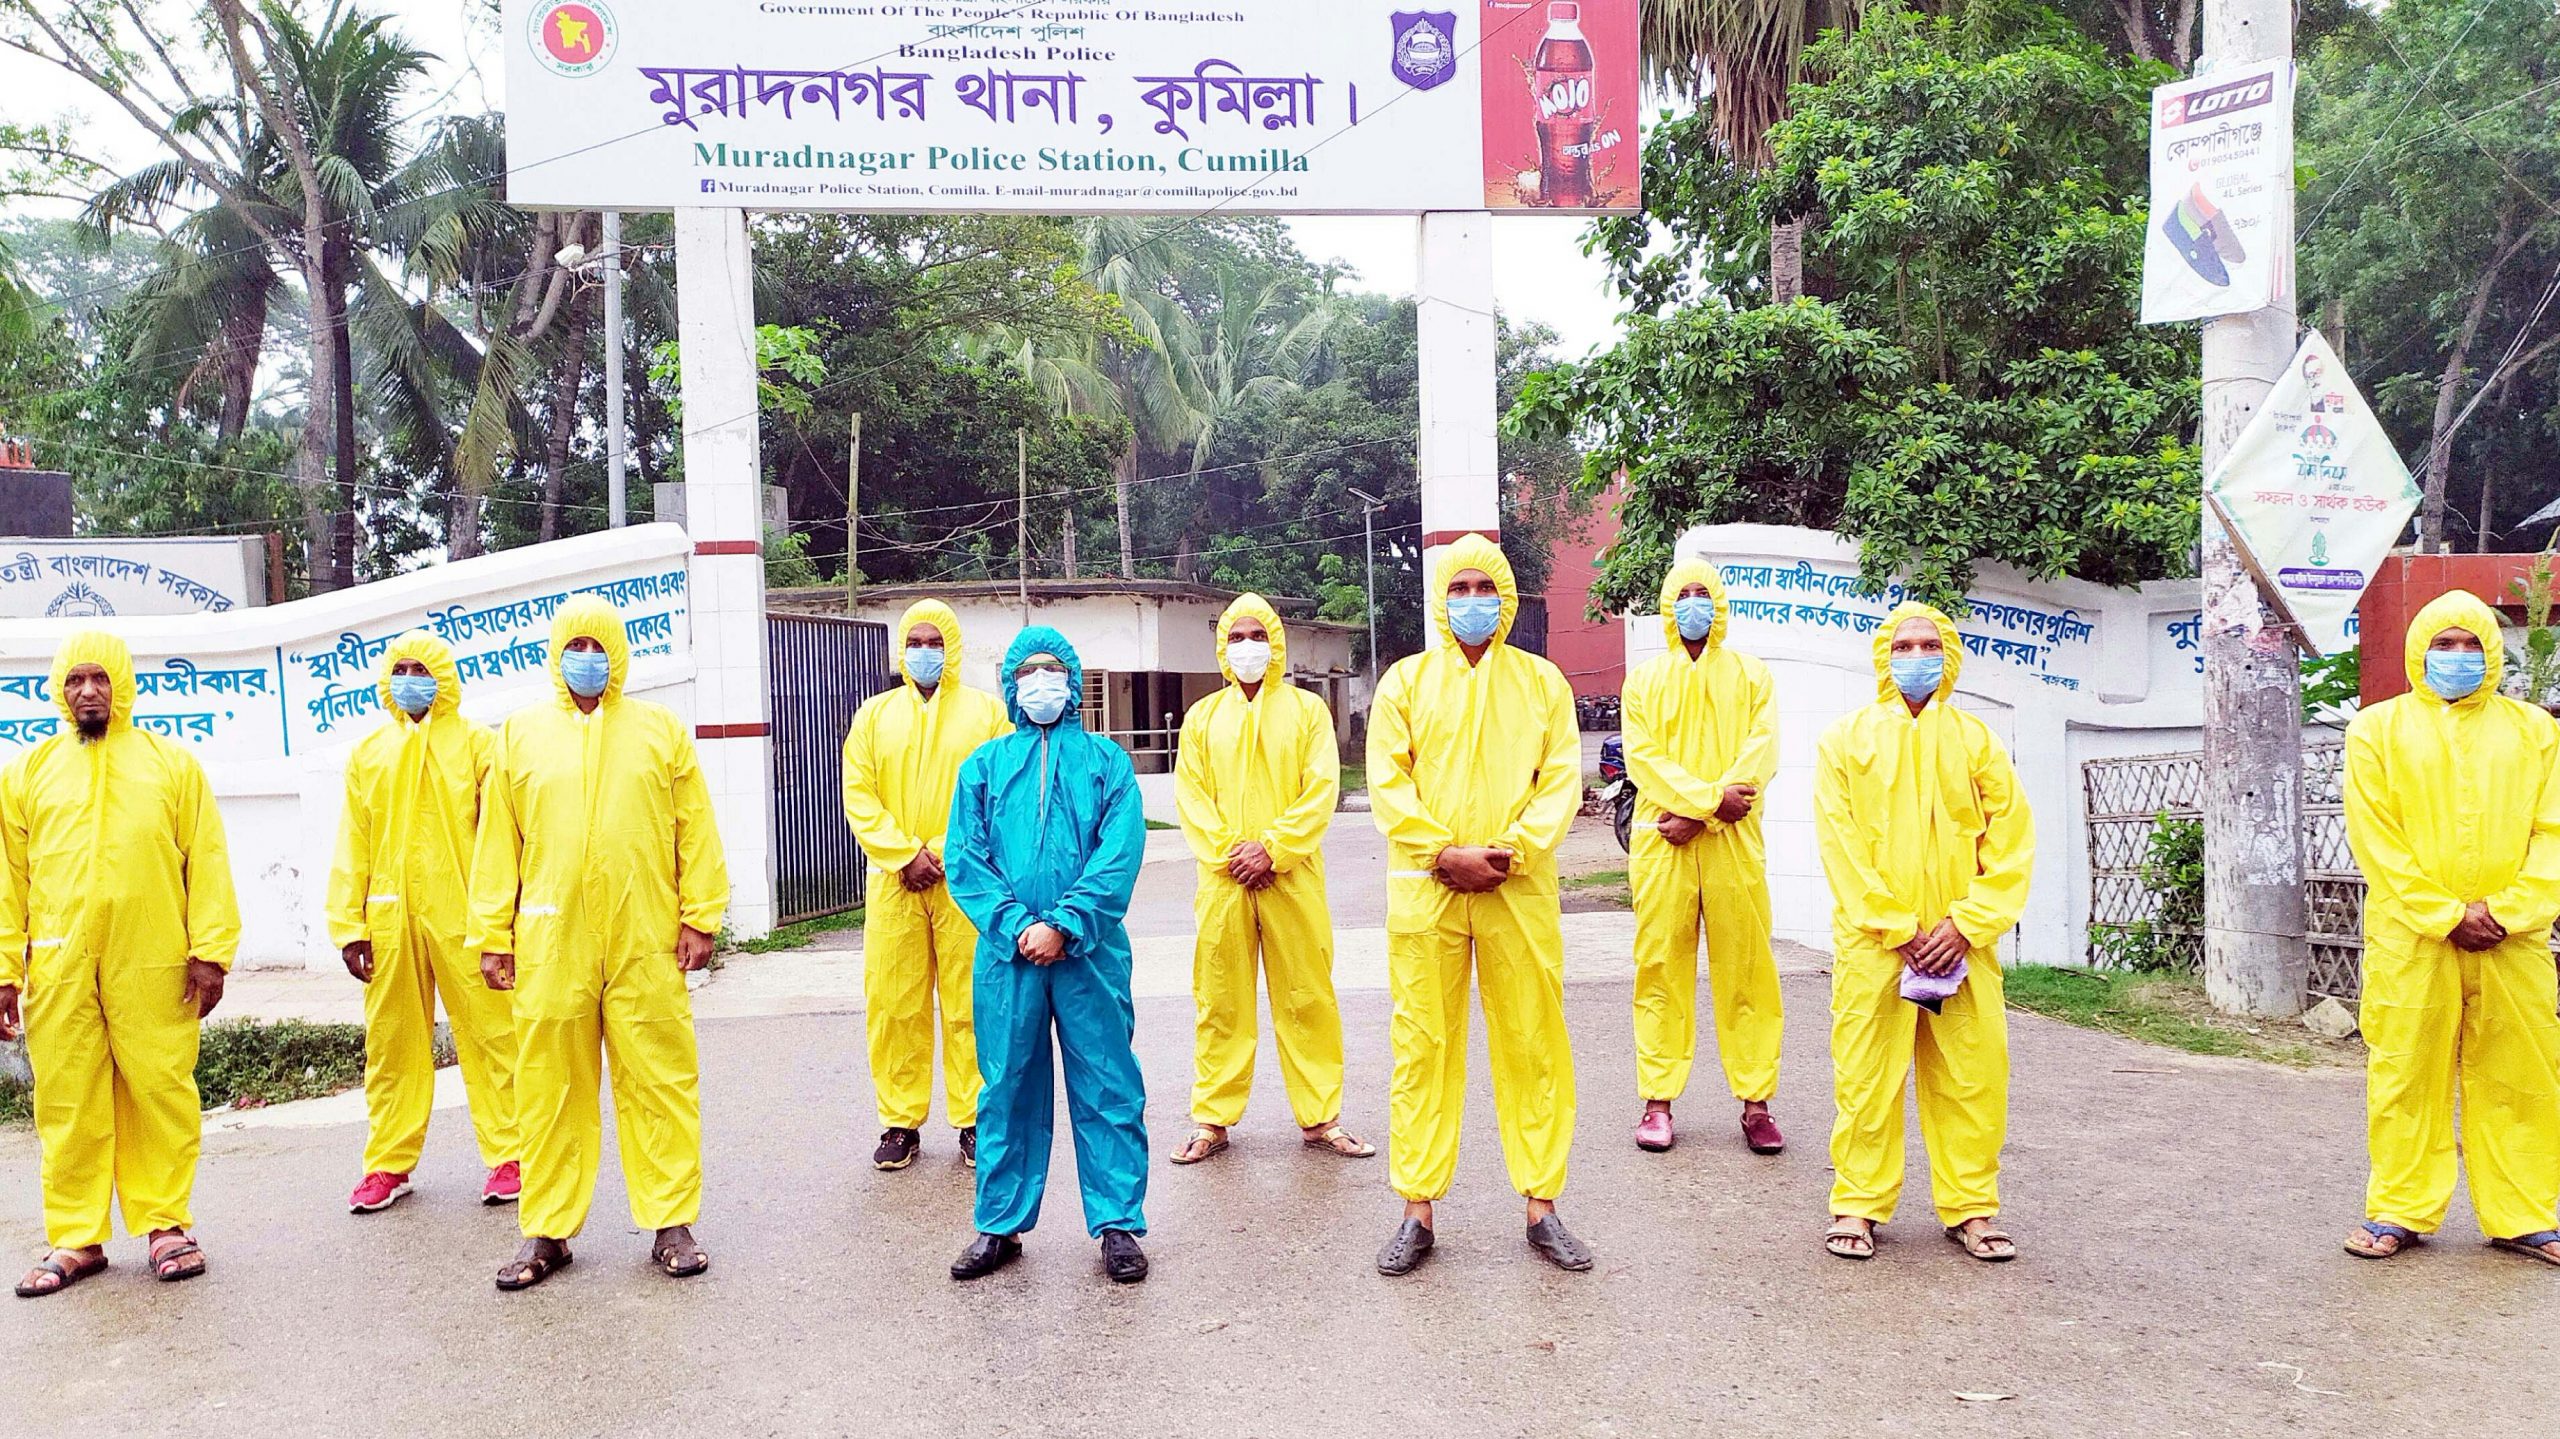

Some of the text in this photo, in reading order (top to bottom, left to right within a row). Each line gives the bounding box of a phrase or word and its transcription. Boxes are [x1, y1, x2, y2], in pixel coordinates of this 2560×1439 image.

[759, 2, 1245, 24] Government Of The People's Republic Of Bangladesh
[928, 22, 1085, 43] বাংলাদেশ পুলিশ
[899, 43, 1117, 63] Bangladesh Police
[637, 62, 935, 132] মুরাদনগর
[1132, 58, 1325, 142] কুমিল্লা
[1538, 78, 1590, 120] MOJO
[2187, 80, 2271, 117] LOTTO
[1600, 129, 1622, 149] ON
[692, 142, 1312, 177] Muradnagar Police Station, Cumilla
[719, 181, 815, 196] Muradnagar
[819, 183, 864, 195] Police
[867, 183, 924, 196] Station,
[928, 184, 990, 196] Comilla.
[2253, 490, 2389, 512] সফল ও সার্থক হউক
[47, 553, 153, 586] বাংলাদেশ
[158, 567, 236, 613] সরকার
[427, 604, 534, 647] ইতিহাসের
[656, 570, 686, 598] এবং
[1775, 560, 1829, 593] স্বাধীন
[1964, 598, 2048, 637] নগণের
[2046, 609, 2095, 648] পুলিশ
[1795, 601, 1851, 632] কর্তব্য
[307, 682, 382, 733] পুলিশে
